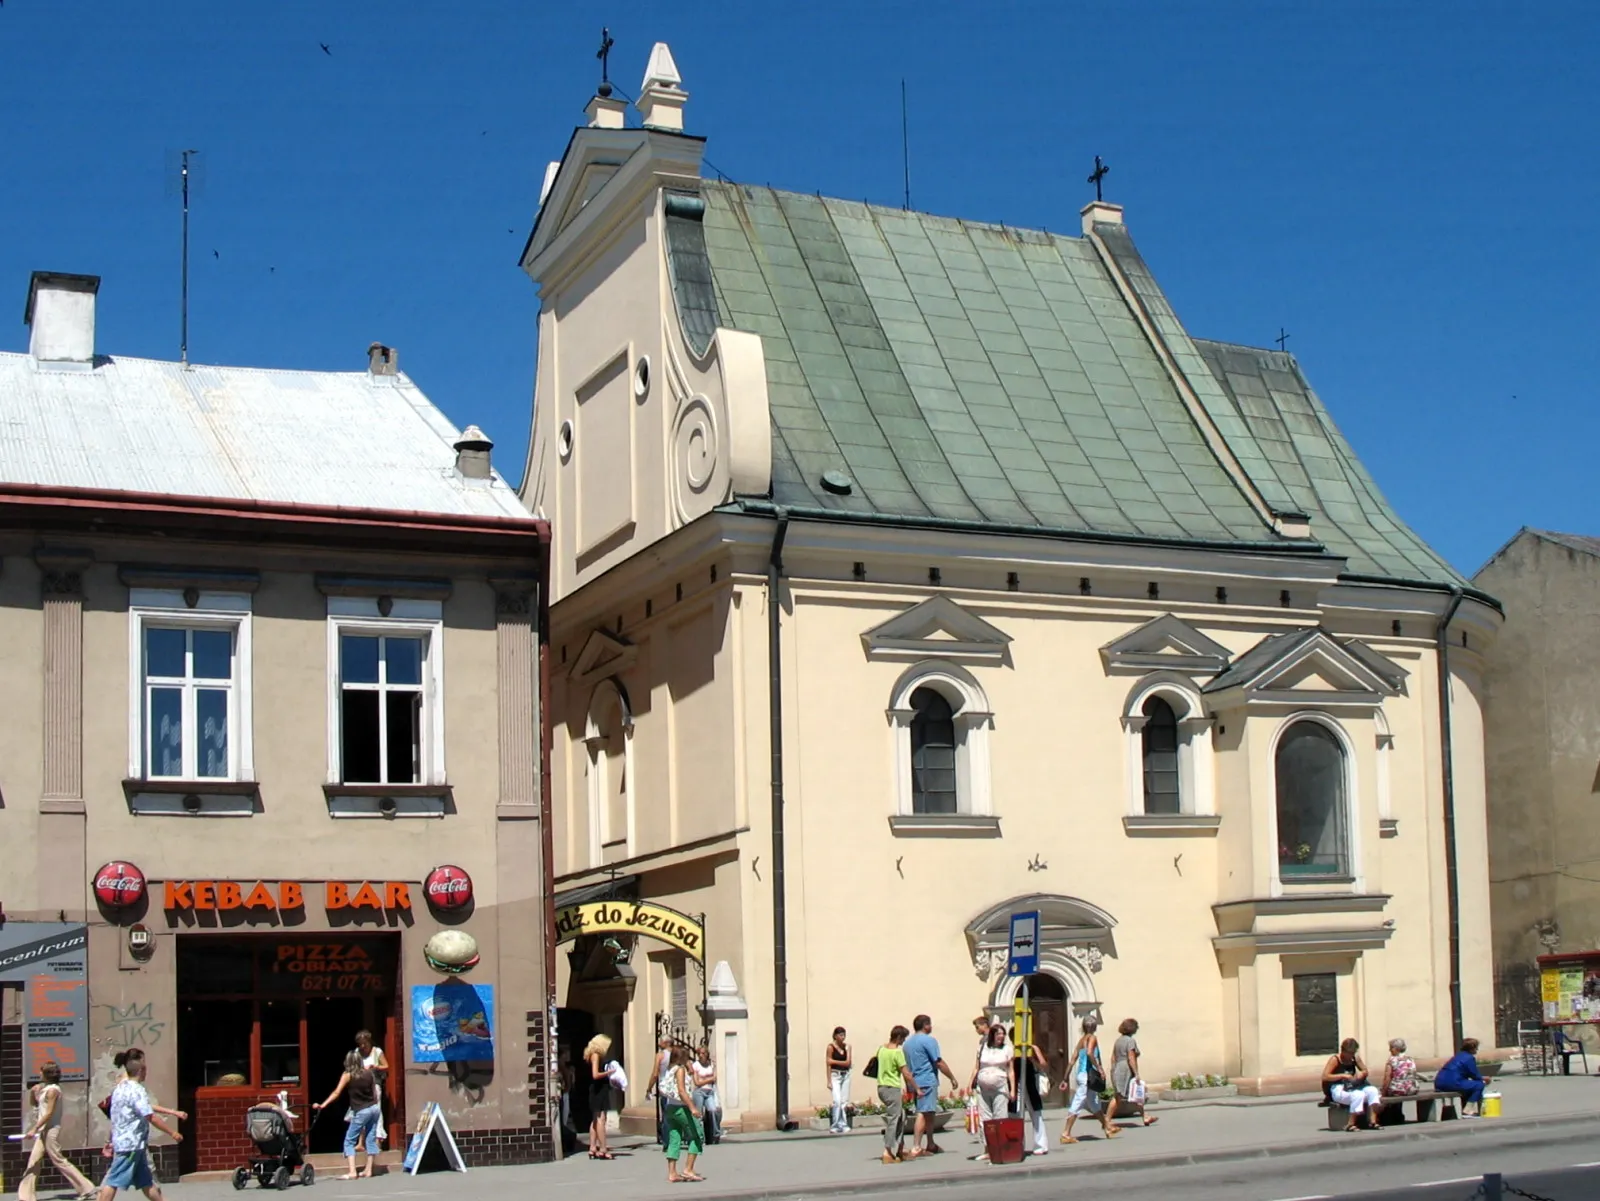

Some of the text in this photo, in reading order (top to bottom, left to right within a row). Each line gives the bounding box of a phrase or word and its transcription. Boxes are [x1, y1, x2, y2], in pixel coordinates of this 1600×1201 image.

[164, 880, 412, 910] KEBAB BAR
[594, 903, 622, 925] do
[625, 902, 700, 950] Jezusa
[0, 936, 85, 967] centrum
[277, 945, 368, 960] PIZZA
[287, 960, 373, 973] OBIADY
[302, 974, 332, 991] 621
[337, 973, 360, 991] 07
